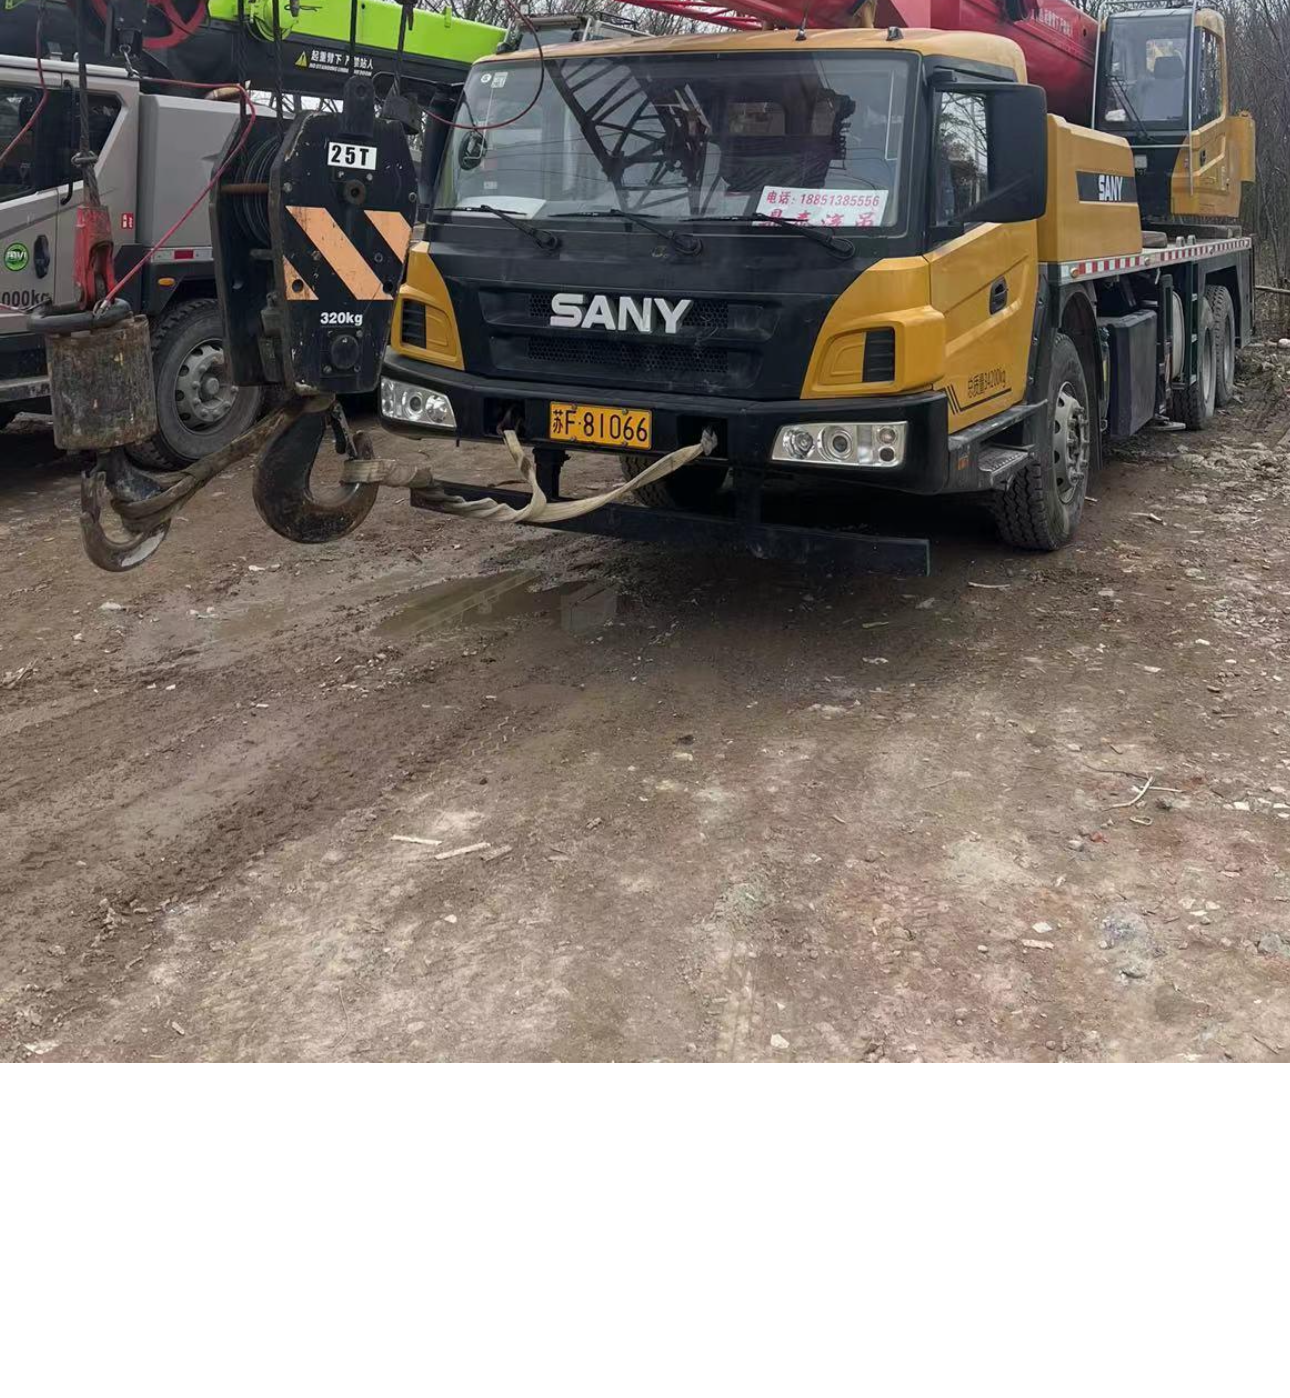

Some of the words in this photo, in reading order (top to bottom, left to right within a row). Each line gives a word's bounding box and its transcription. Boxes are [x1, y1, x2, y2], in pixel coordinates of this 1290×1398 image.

[330, 144, 370, 167] 25T
[1098, 174, 1123, 201] SANY
[320, 311, 363, 327] 320kg
[549, 292, 692, 334] SANY
